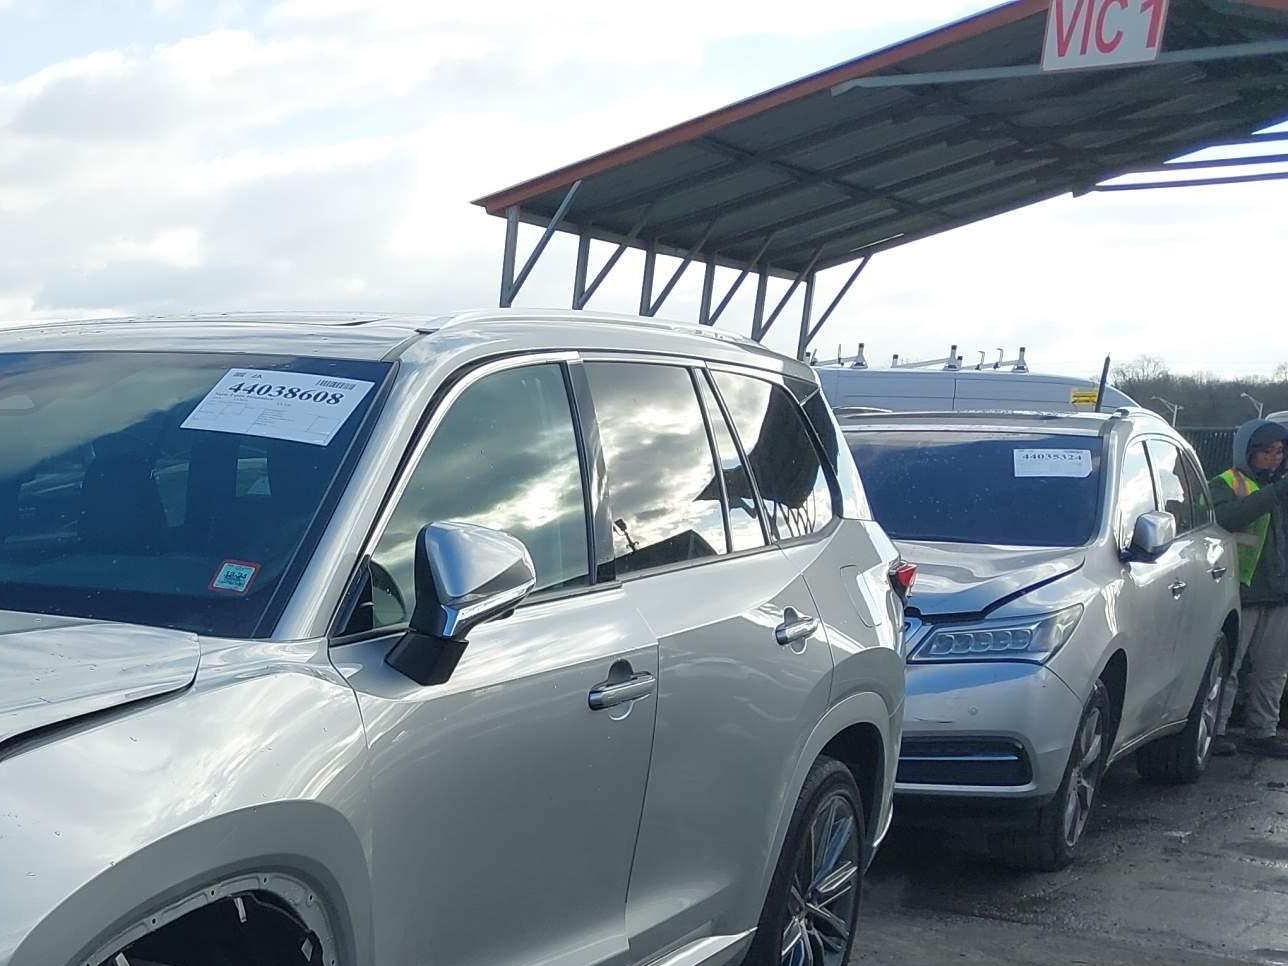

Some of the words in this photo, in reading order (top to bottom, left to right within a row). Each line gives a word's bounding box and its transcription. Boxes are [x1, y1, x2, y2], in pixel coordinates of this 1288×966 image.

[1054, 0, 1128, 57] VIC
[1140, 0, 1161, 48] 1
[228, 382, 345, 405] 44038608
